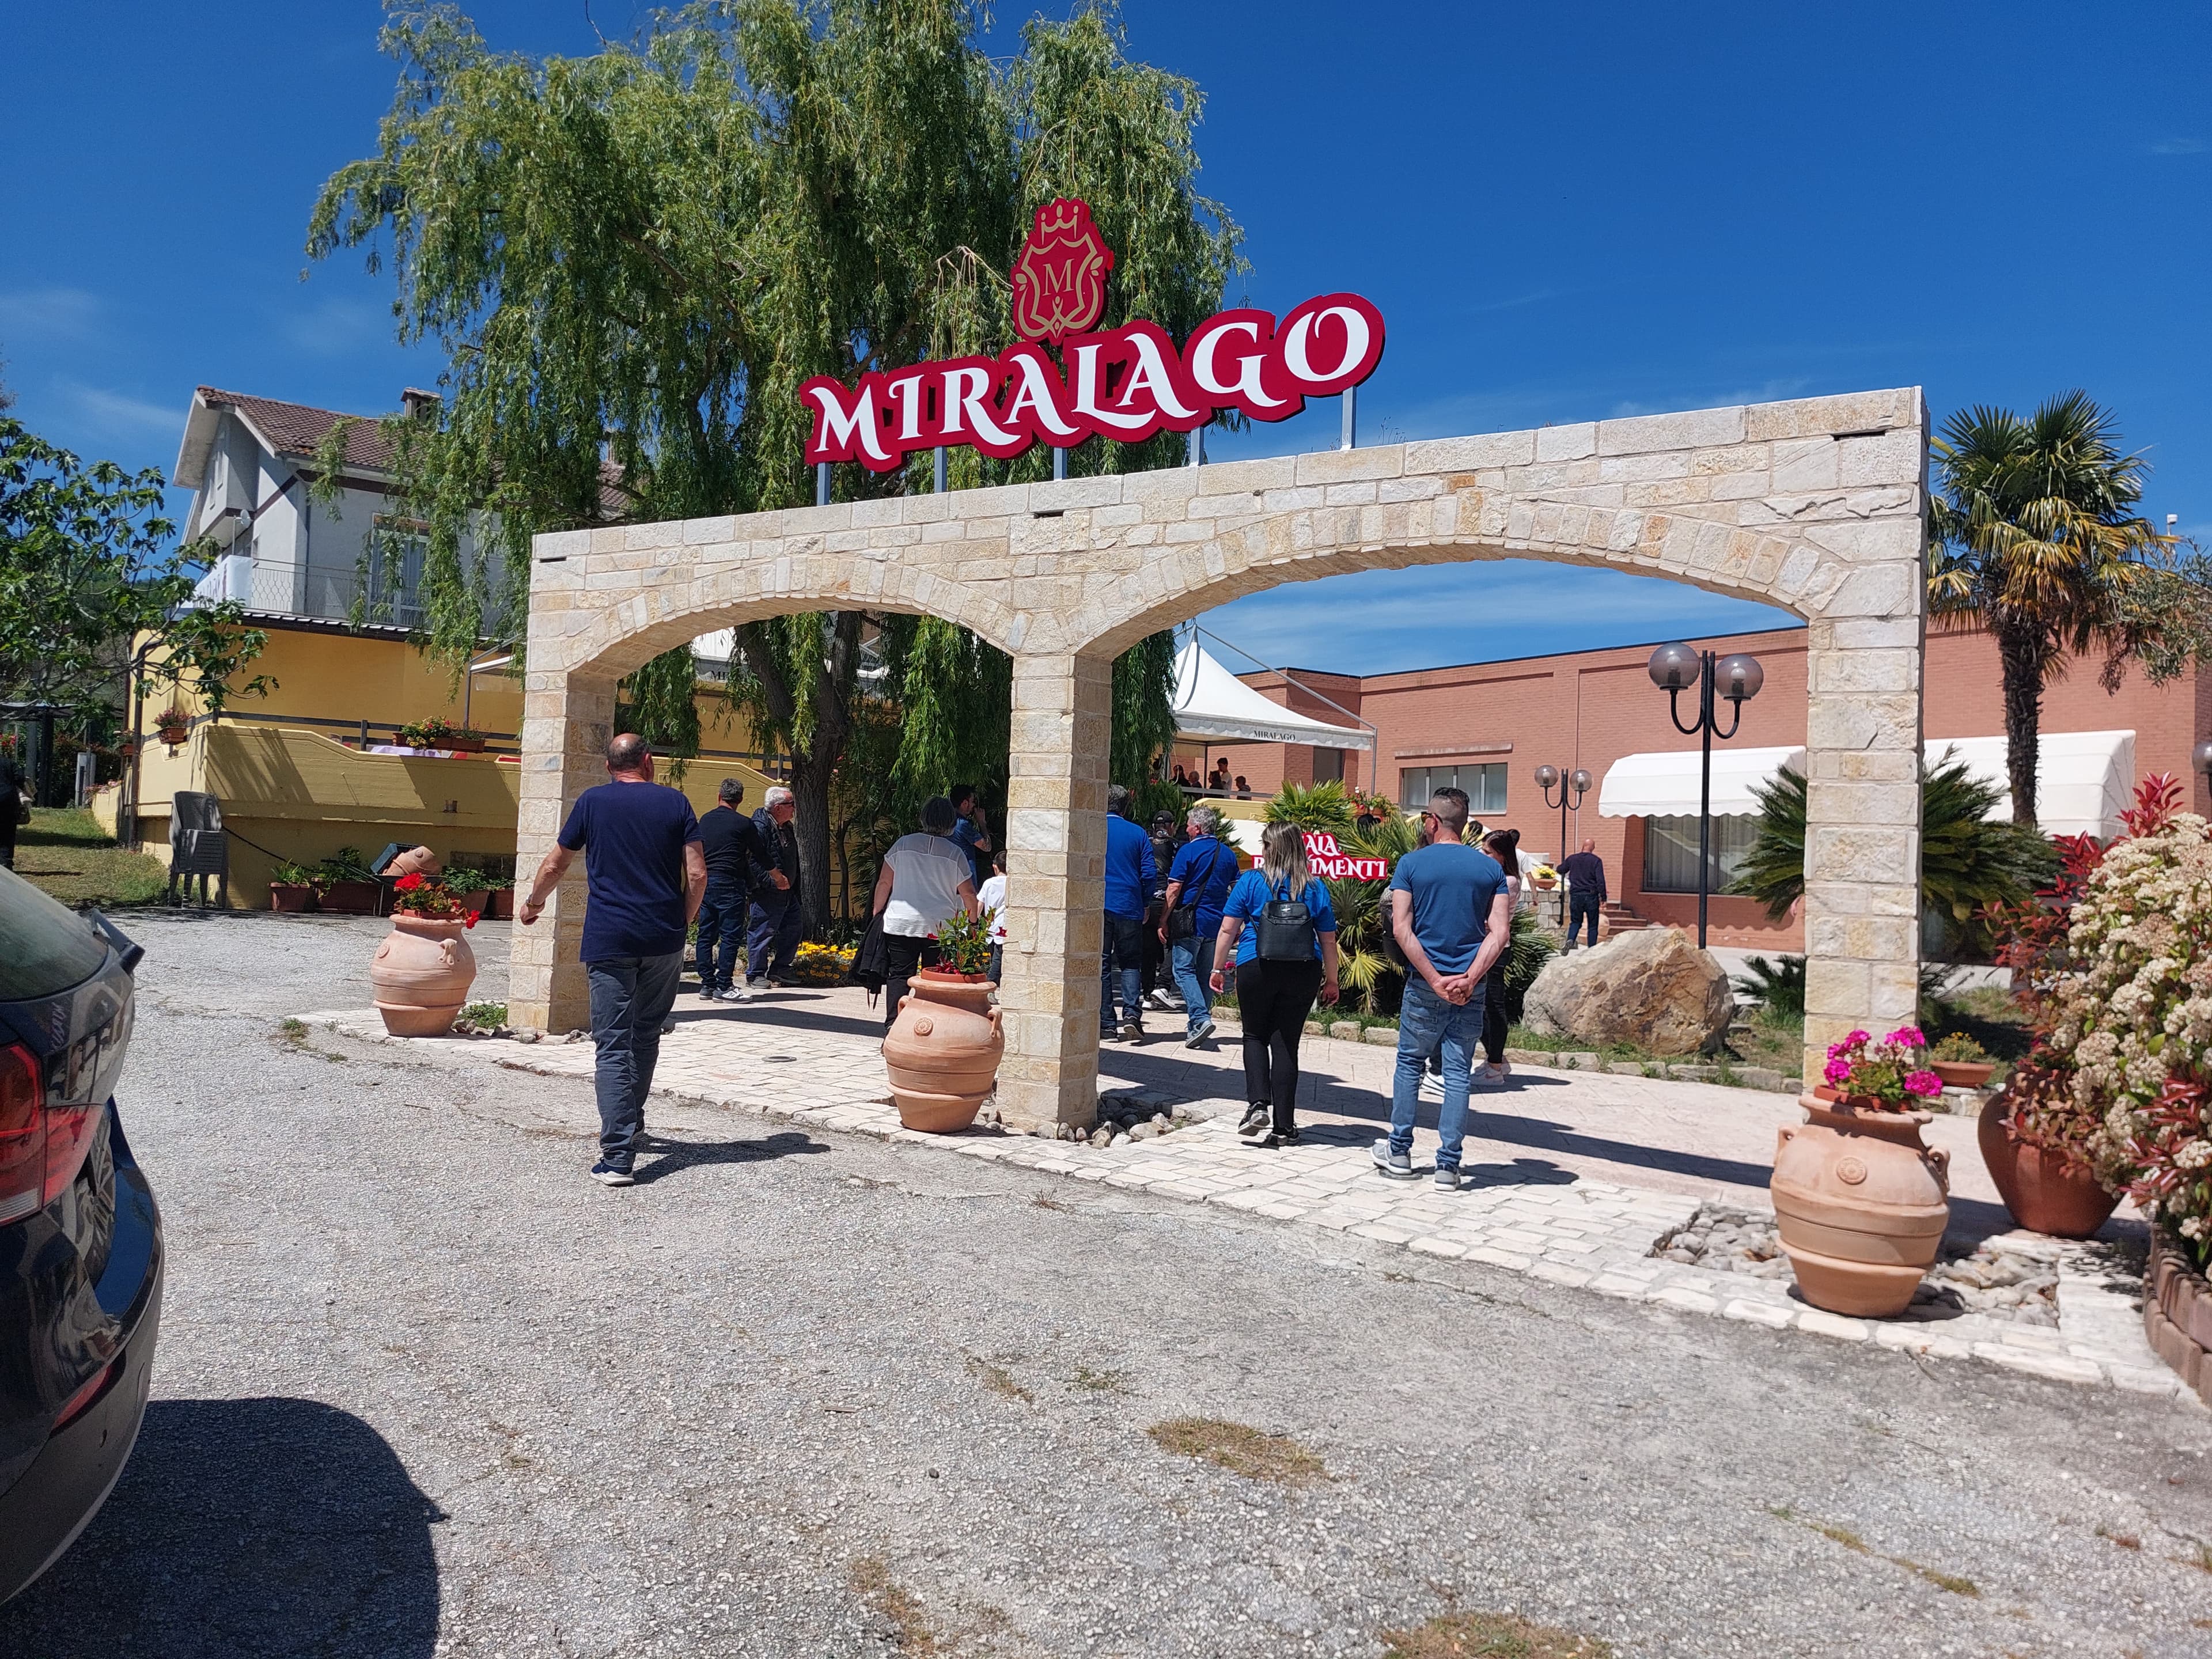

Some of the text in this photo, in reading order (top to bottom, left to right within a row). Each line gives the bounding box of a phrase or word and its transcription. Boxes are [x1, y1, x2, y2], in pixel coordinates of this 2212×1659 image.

[1041, 258, 1075, 296] M
[808, 306, 1370, 460] MIRALAGO
[1253, 730, 1296, 741] MIRALAGO
[1303, 835, 1342, 857] ALA
